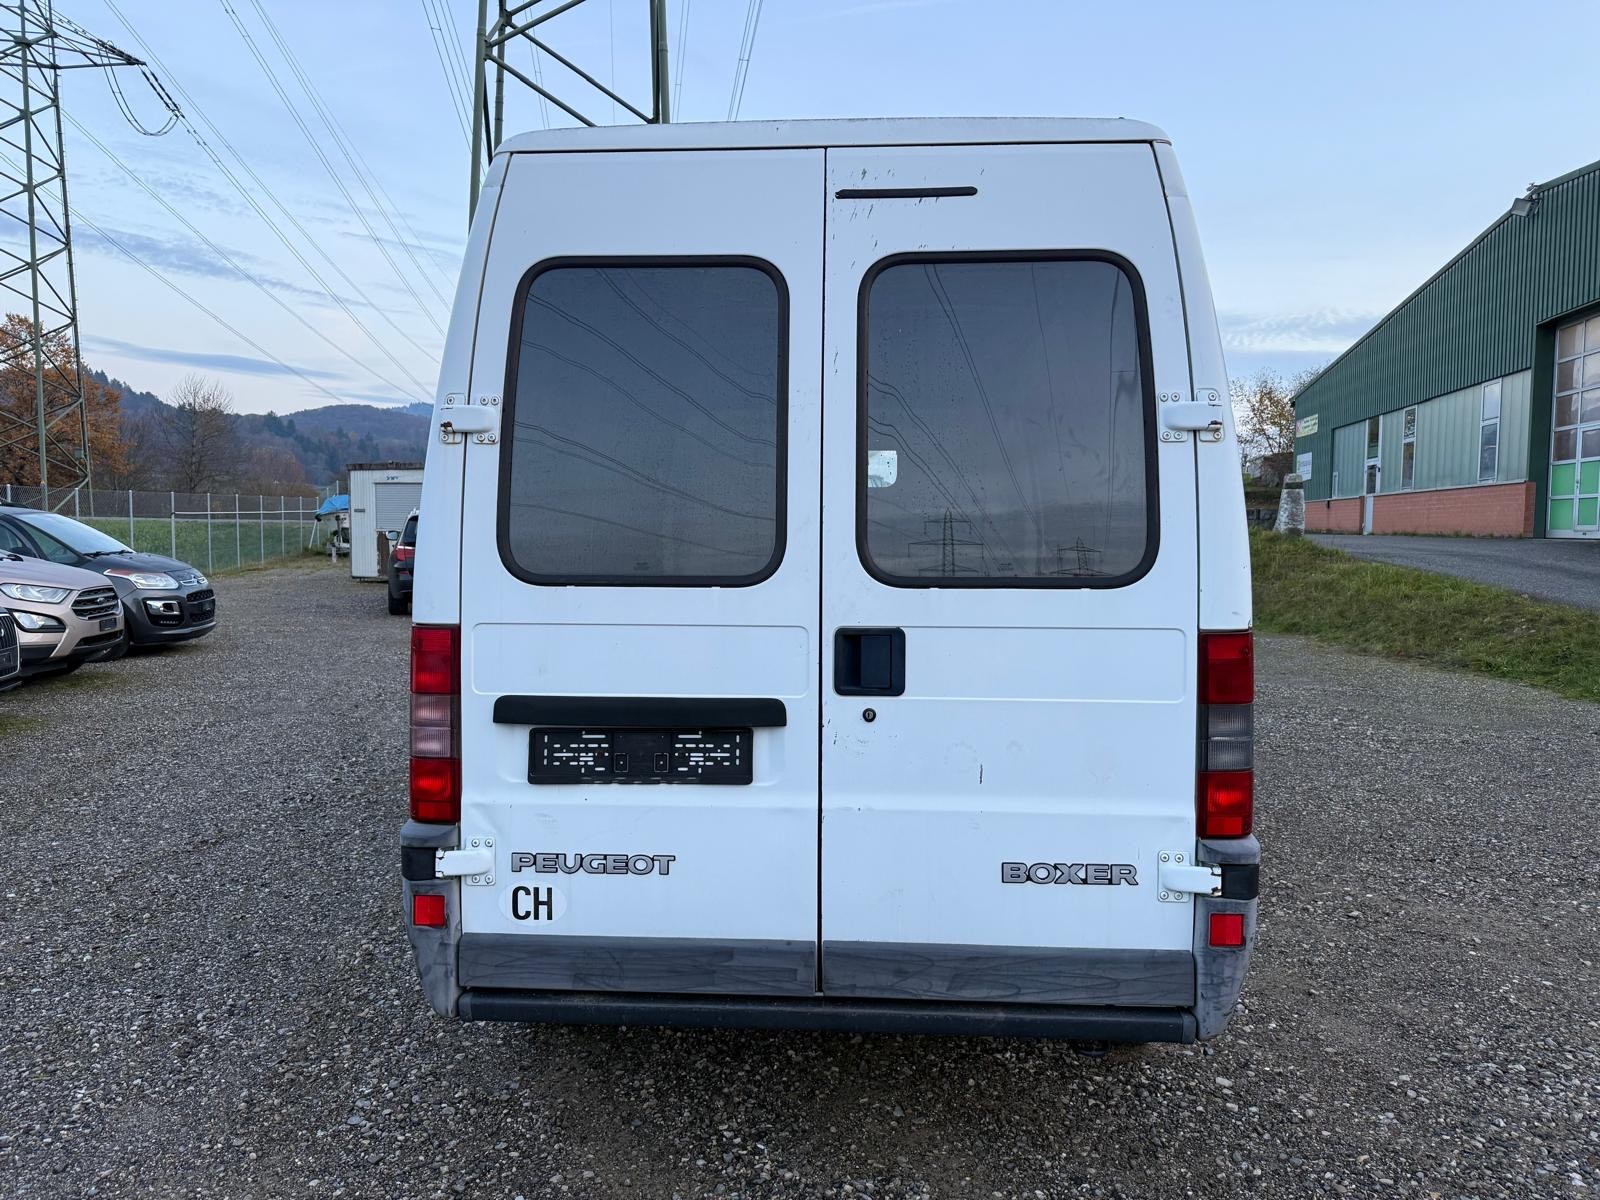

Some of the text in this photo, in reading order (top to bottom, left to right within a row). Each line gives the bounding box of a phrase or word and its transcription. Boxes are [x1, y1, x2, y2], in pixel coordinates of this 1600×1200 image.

[511, 852, 676, 875] PEUGEOT
[1001, 862, 1139, 885] BOXER
[511, 885, 553, 921] CH
